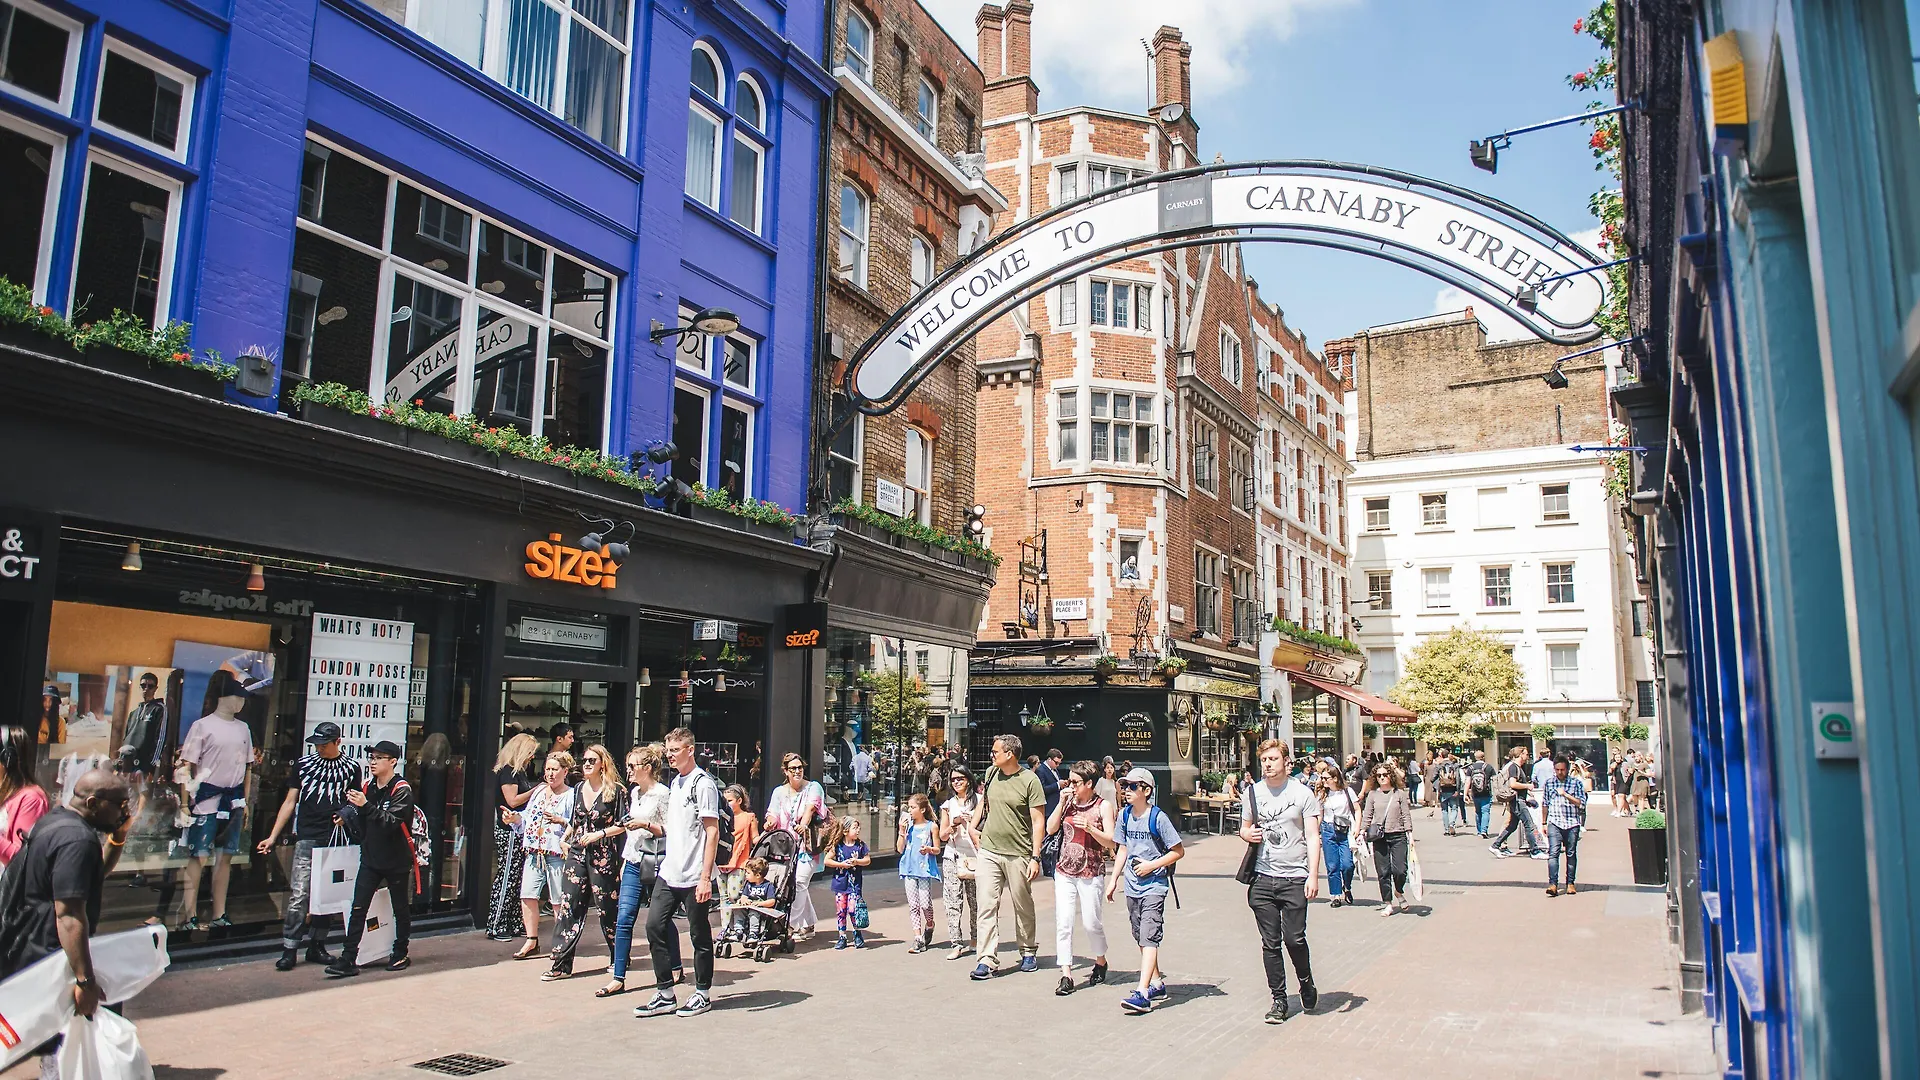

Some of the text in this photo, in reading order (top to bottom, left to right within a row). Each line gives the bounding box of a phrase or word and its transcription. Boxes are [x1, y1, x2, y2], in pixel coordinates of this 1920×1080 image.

[1166, 198, 1204, 210] CARNABY
[895, 185, 1575, 352] WELCOME TO CARNABY STREET
[2, 529, 23, 552] &
[320, 617, 402, 639] WHATS HOT?
[557, 629, 594, 640] CARNABY
[785, 629, 820, 647] size?
[312, 659, 406, 679] LONDON POSSE
[317, 681, 397, 699] PERFORMING
[333, 702, 387, 718] INSTORE
[341, 724, 371, 739] LIVE
[1136, 731, 1152, 739] ALES
